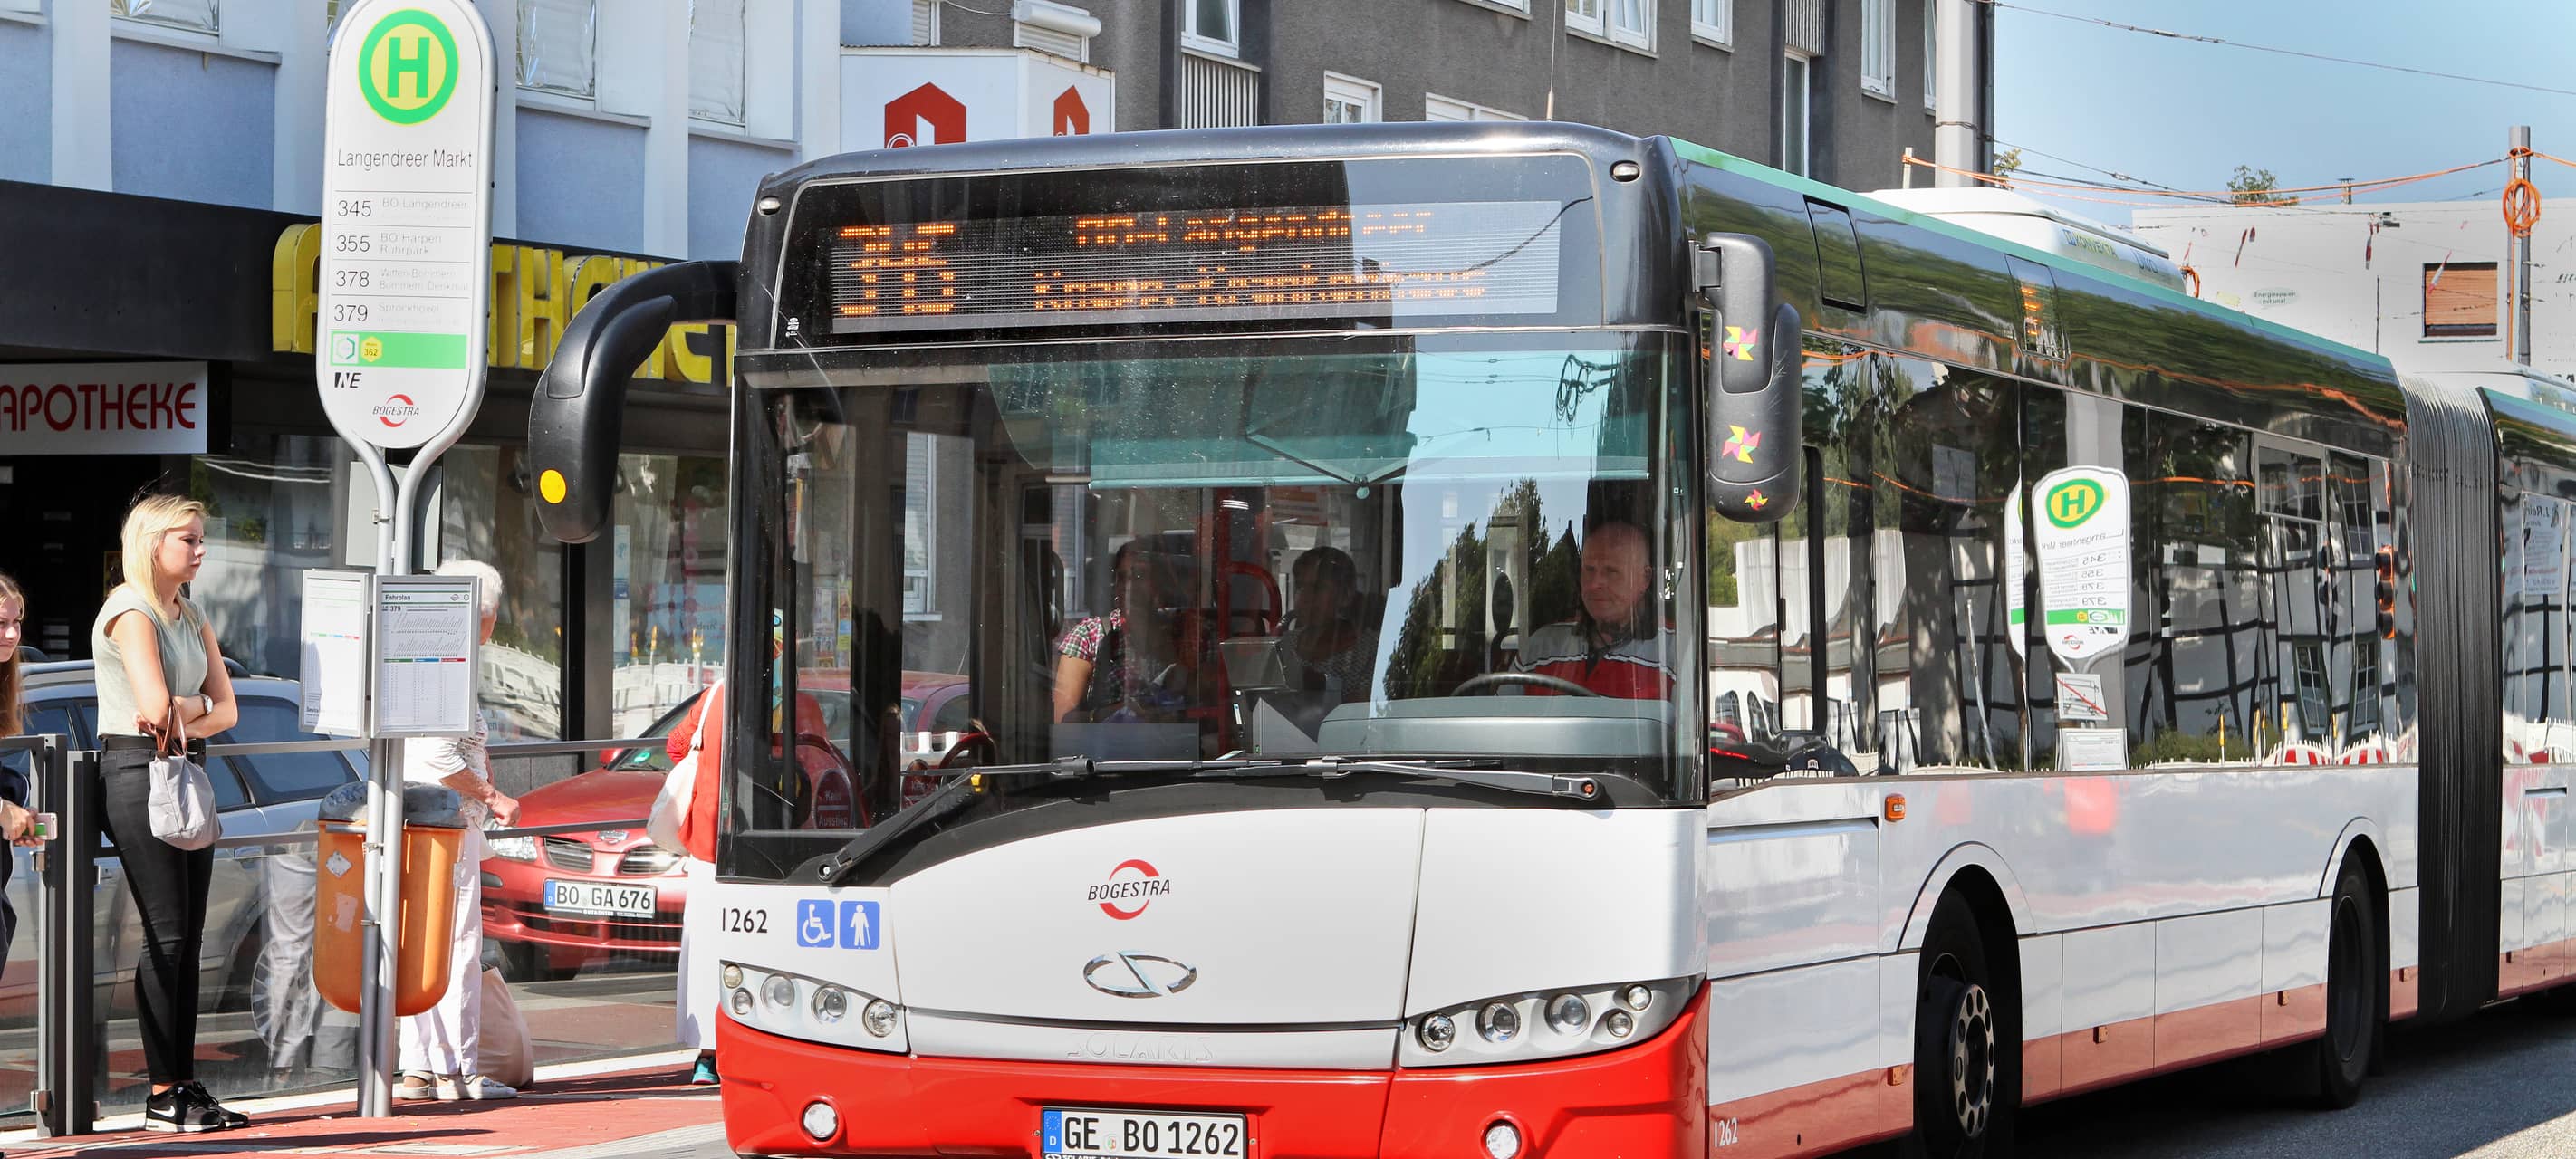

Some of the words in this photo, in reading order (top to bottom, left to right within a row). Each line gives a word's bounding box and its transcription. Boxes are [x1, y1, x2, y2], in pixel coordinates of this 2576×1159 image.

[387, 36, 430, 98] H
[338, 148, 428, 172] Langendreer
[433, 149, 472, 168] Markt
[337, 200, 372, 217] 345
[336, 235, 370, 253] 355
[335, 270, 370, 288] 378
[333, 304, 369, 322] 379
[364, 348, 378, 357] 362
[0, 382, 197, 432] APOTHEKE
[372, 405, 420, 417] BOGESTRA
[385, 594, 411, 602] Fahrplan
[556, 886, 580, 905] BO
[591, 888, 614, 908] GA
[618, 889, 651, 910] 676
[1088, 879, 1170, 901] BOGESTRA
[722, 907, 768, 934] 1262
[1064, 1116, 1100, 1151] GE
[1123, 1119, 1159, 1153] BO
[1167, 1121, 1239, 1156] 1262
[1714, 1116, 1738, 1147] 1262
